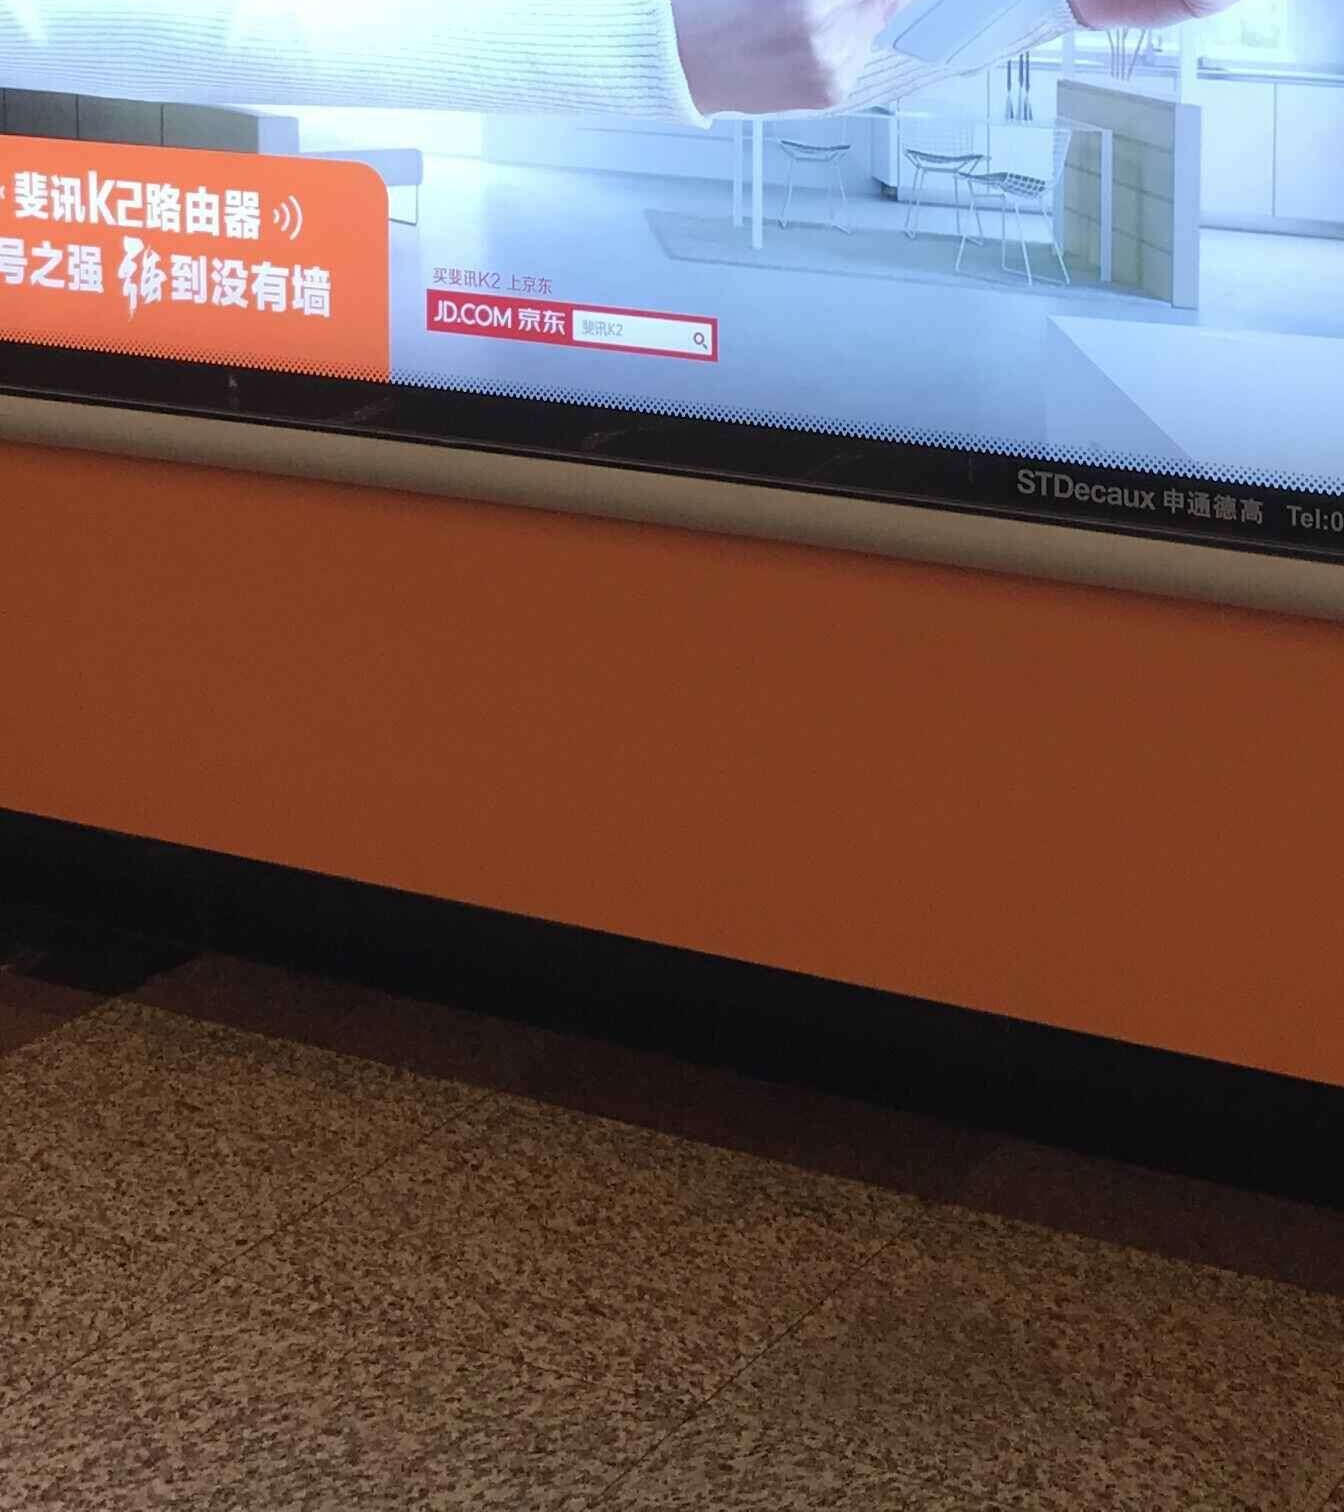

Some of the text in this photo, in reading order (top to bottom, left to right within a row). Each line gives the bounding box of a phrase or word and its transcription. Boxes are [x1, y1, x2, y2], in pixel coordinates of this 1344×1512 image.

[433, 300, 567, 335] JD.COM 京东
[1016, 468, 1156, 511] STDecaux
[1163, 488, 1264, 525] 申通德高
